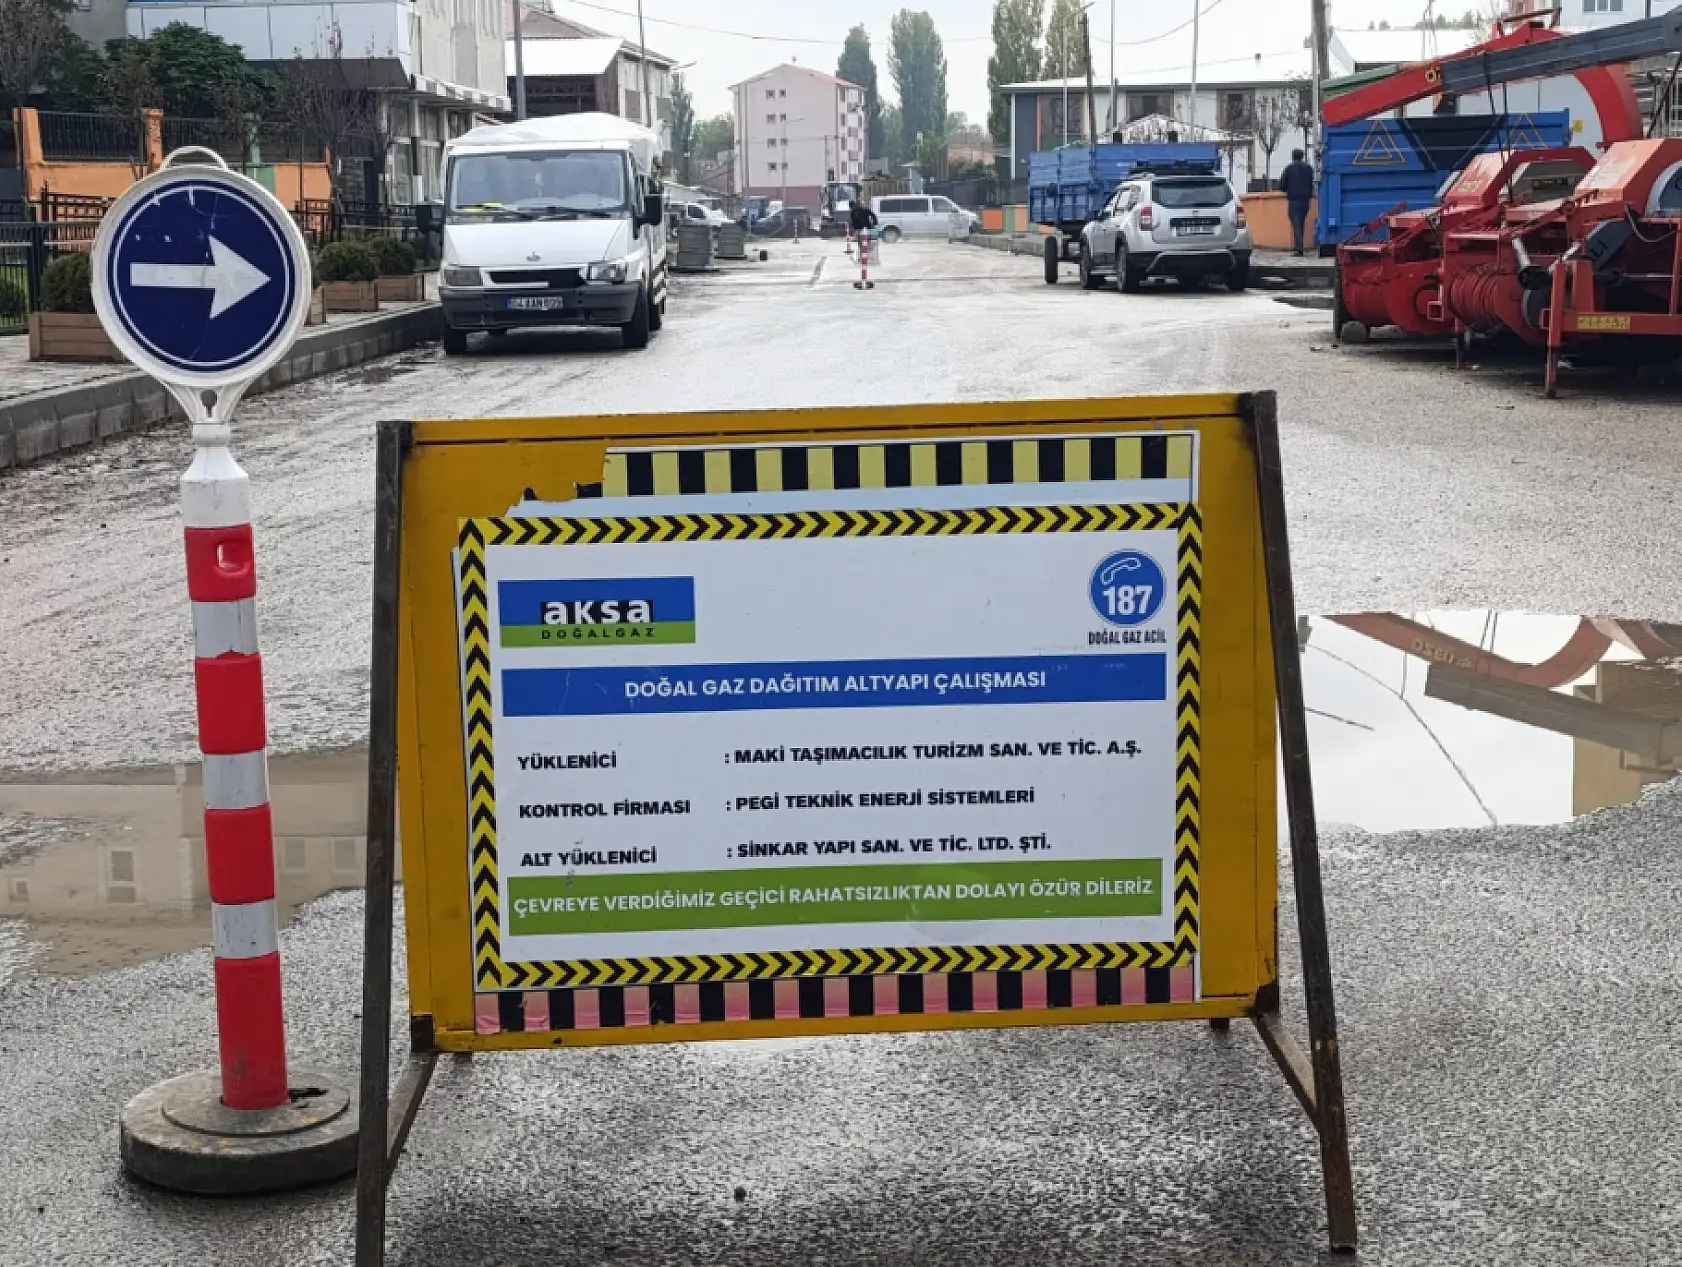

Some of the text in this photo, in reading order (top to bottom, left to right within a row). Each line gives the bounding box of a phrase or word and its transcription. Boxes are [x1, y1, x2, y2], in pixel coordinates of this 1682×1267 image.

[544, 599, 650, 624] aksa
[1103, 585, 1152, 616] 187
[1088, 628, 1167, 645] DOĞAL GAZ ACİL
[624, 671, 1046, 698] DOĞAL GAZ DAĞITIM ALTYAPI ÇALIŞMASI
[518, 751, 617, 770] YÜKLENİCİ
[735, 745, 785, 763] MAKİ
[789, 745, 907, 765] TAŞIMACILIK
[913, 741, 984, 759] TURİZM
[990, 742, 1032, 757] SAN.
[1038, 742, 1061, 755] VE
[1067, 739, 1101, 755] TİC.
[1106, 740, 1141, 758] A.Ş.
[519, 803, 607, 818] KONTROL
[614, 799, 691, 816] FİRMASI
[736, 793, 779, 811] PEGİ
[785, 790, 853, 808] TEKNİK
[859, 789, 921, 807] ENERJİ
[927, 787, 1034, 805] SİSTEMLERİ
[520, 852, 551, 866] ALT
[559, 847, 657, 865] YÜKLENİCİ
[737, 841, 808, 858] SİNKAR
[813, 839, 855, 854] YAPI
[861, 839, 904, 853] SAN.
[909, 838, 932, 852] VE
[939, 835, 972, 850] TİC.
[977, 836, 1013, 849] LTD.
[1019, 833, 1051, 852] ŞTİ.
[514, 876, 1154, 918] ÇEVREYE VERDİĞİMİZ GEÇİCİ RAHATSIZLIKTAN DOLAYI ÖZÜR DİLERİZ
